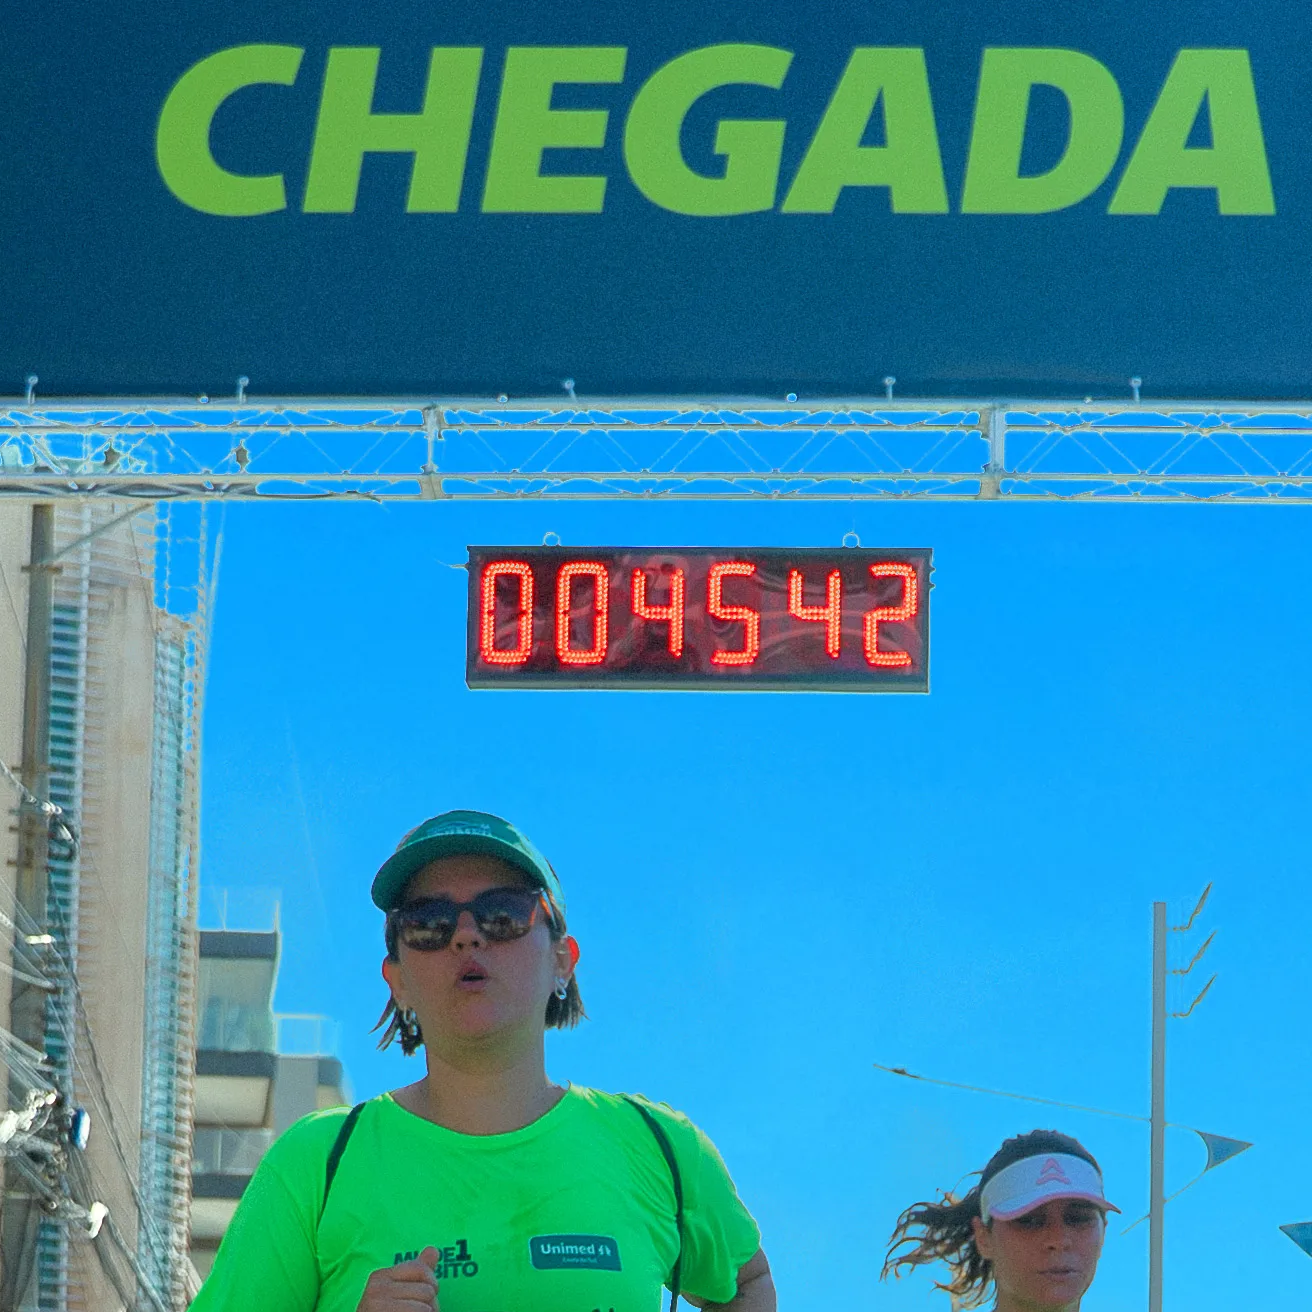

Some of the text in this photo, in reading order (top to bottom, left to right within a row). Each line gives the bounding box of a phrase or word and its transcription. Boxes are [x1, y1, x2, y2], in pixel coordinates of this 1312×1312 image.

[155, 43, 1277, 218] CHEGADA
[480, 561, 919, 667] 004542
[541, 1242, 595, 1255] Unimed
